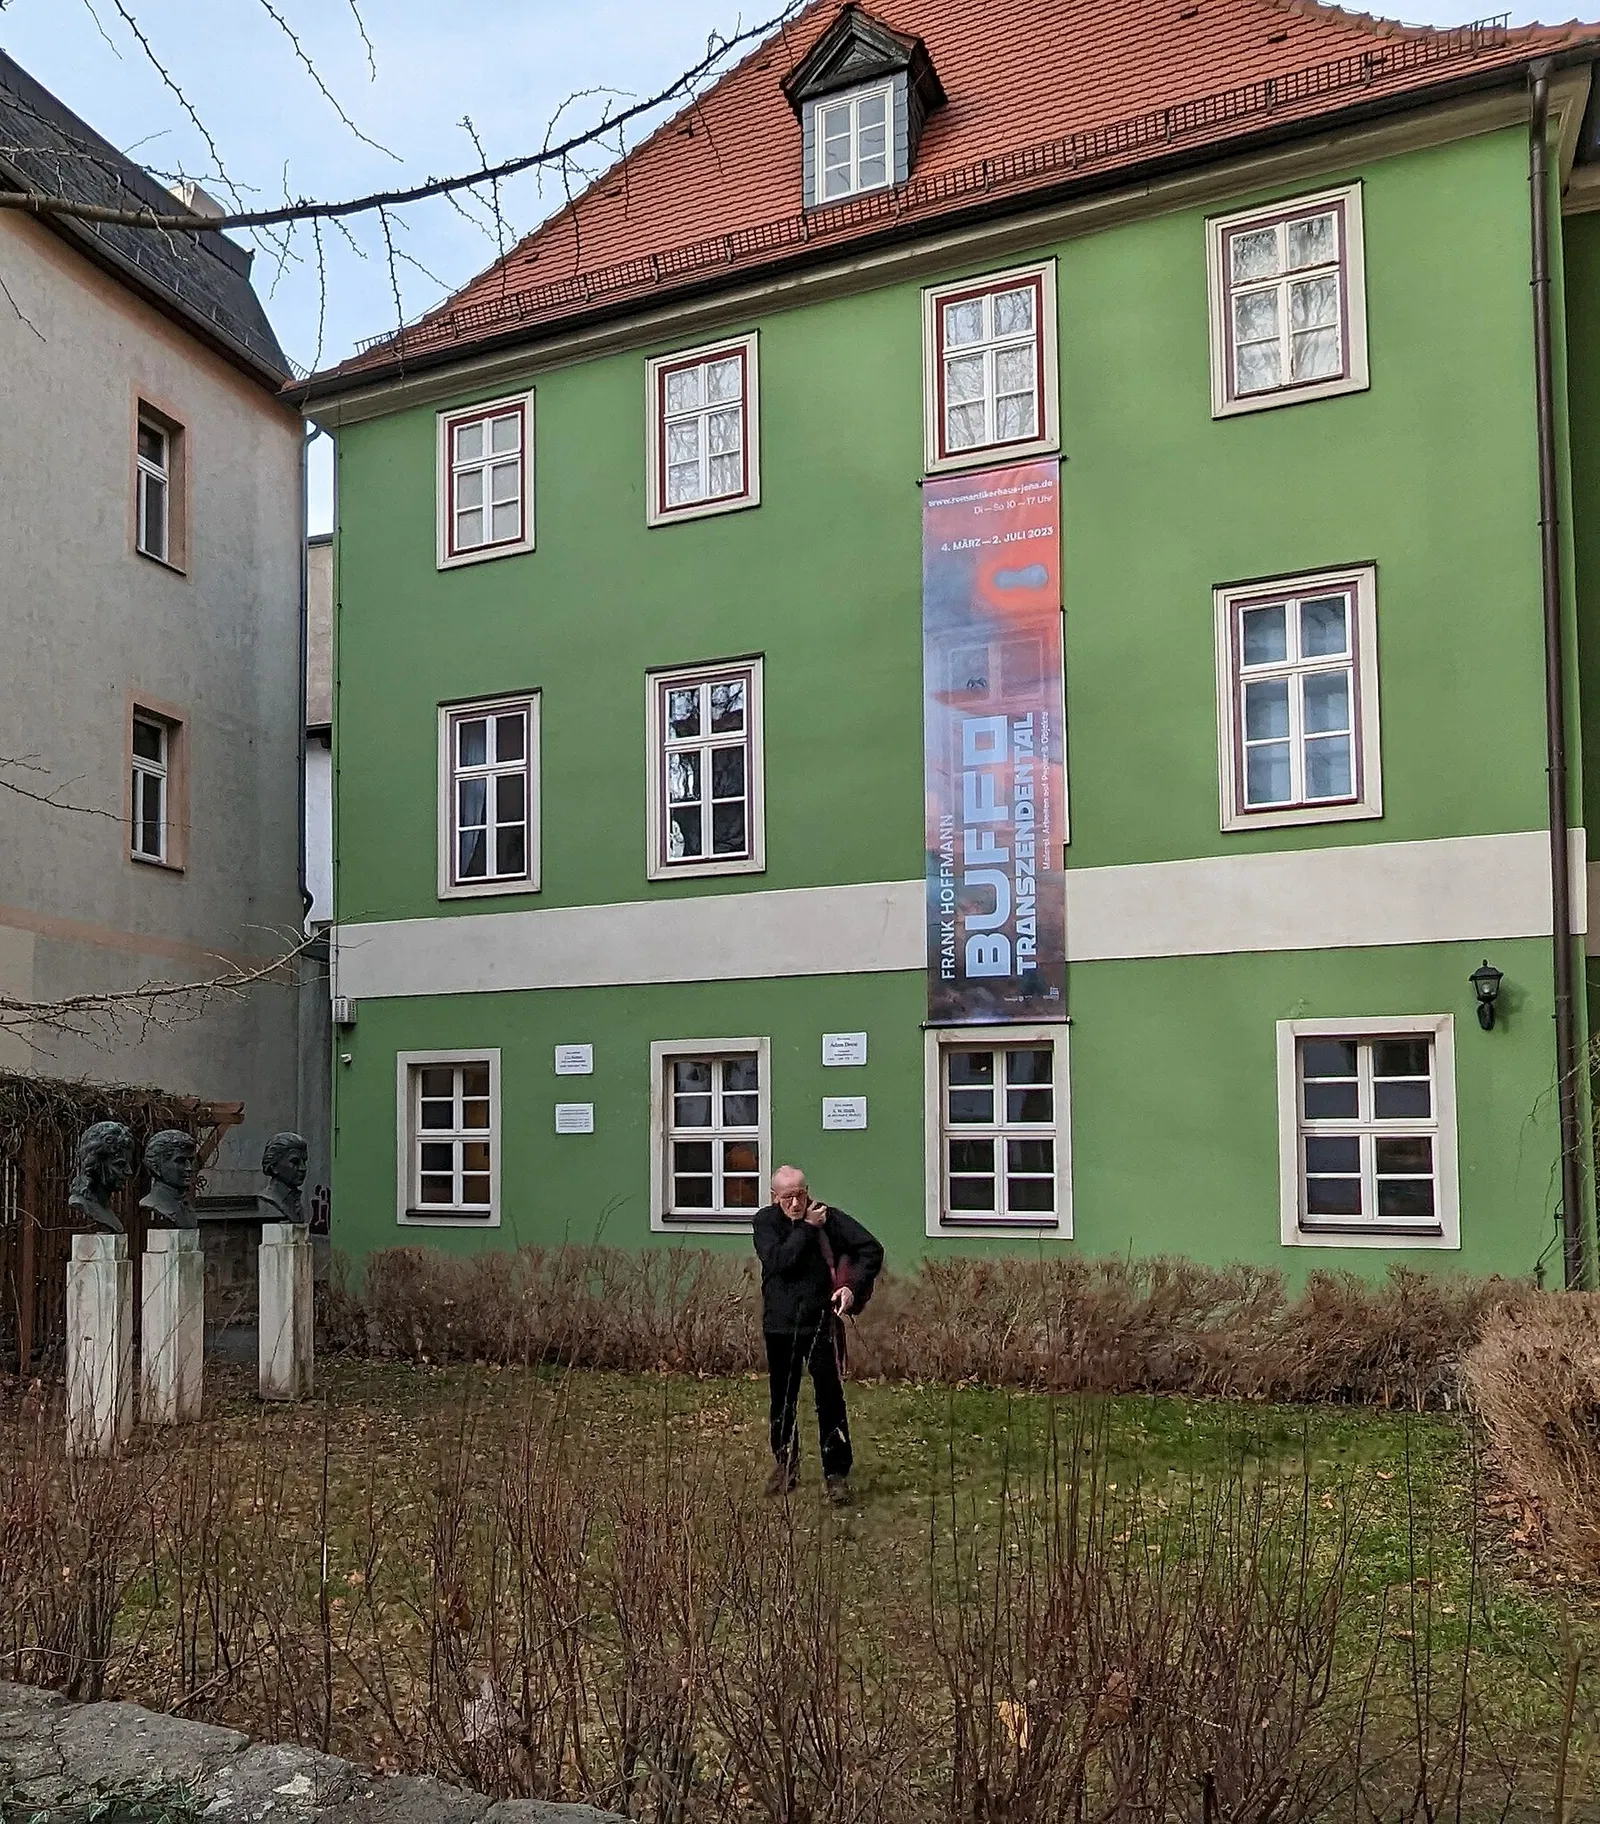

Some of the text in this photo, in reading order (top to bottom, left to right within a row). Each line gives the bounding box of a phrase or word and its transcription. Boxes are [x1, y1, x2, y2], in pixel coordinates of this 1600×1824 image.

[941, 542, 951, 552] 4.
[953, 537, 981, 551] MÄRZ
[992, 535, 1002, 544] 2.
[1004, 531, 1026, 543] JULI
[1028, 526, 1054, 539] 2023
[974, 505, 983, 515] Di
[1007, 499, 1016, 509] 10
[1027, 496, 1036, 506] 17
[1037, 494, 1053, 504] Uhr
[939, 814, 956, 980] FRANK HOFFMANN
[963, 715, 1011, 978] BUFFO
[1014, 712, 1037, 976] TRANSZENDENTAL
